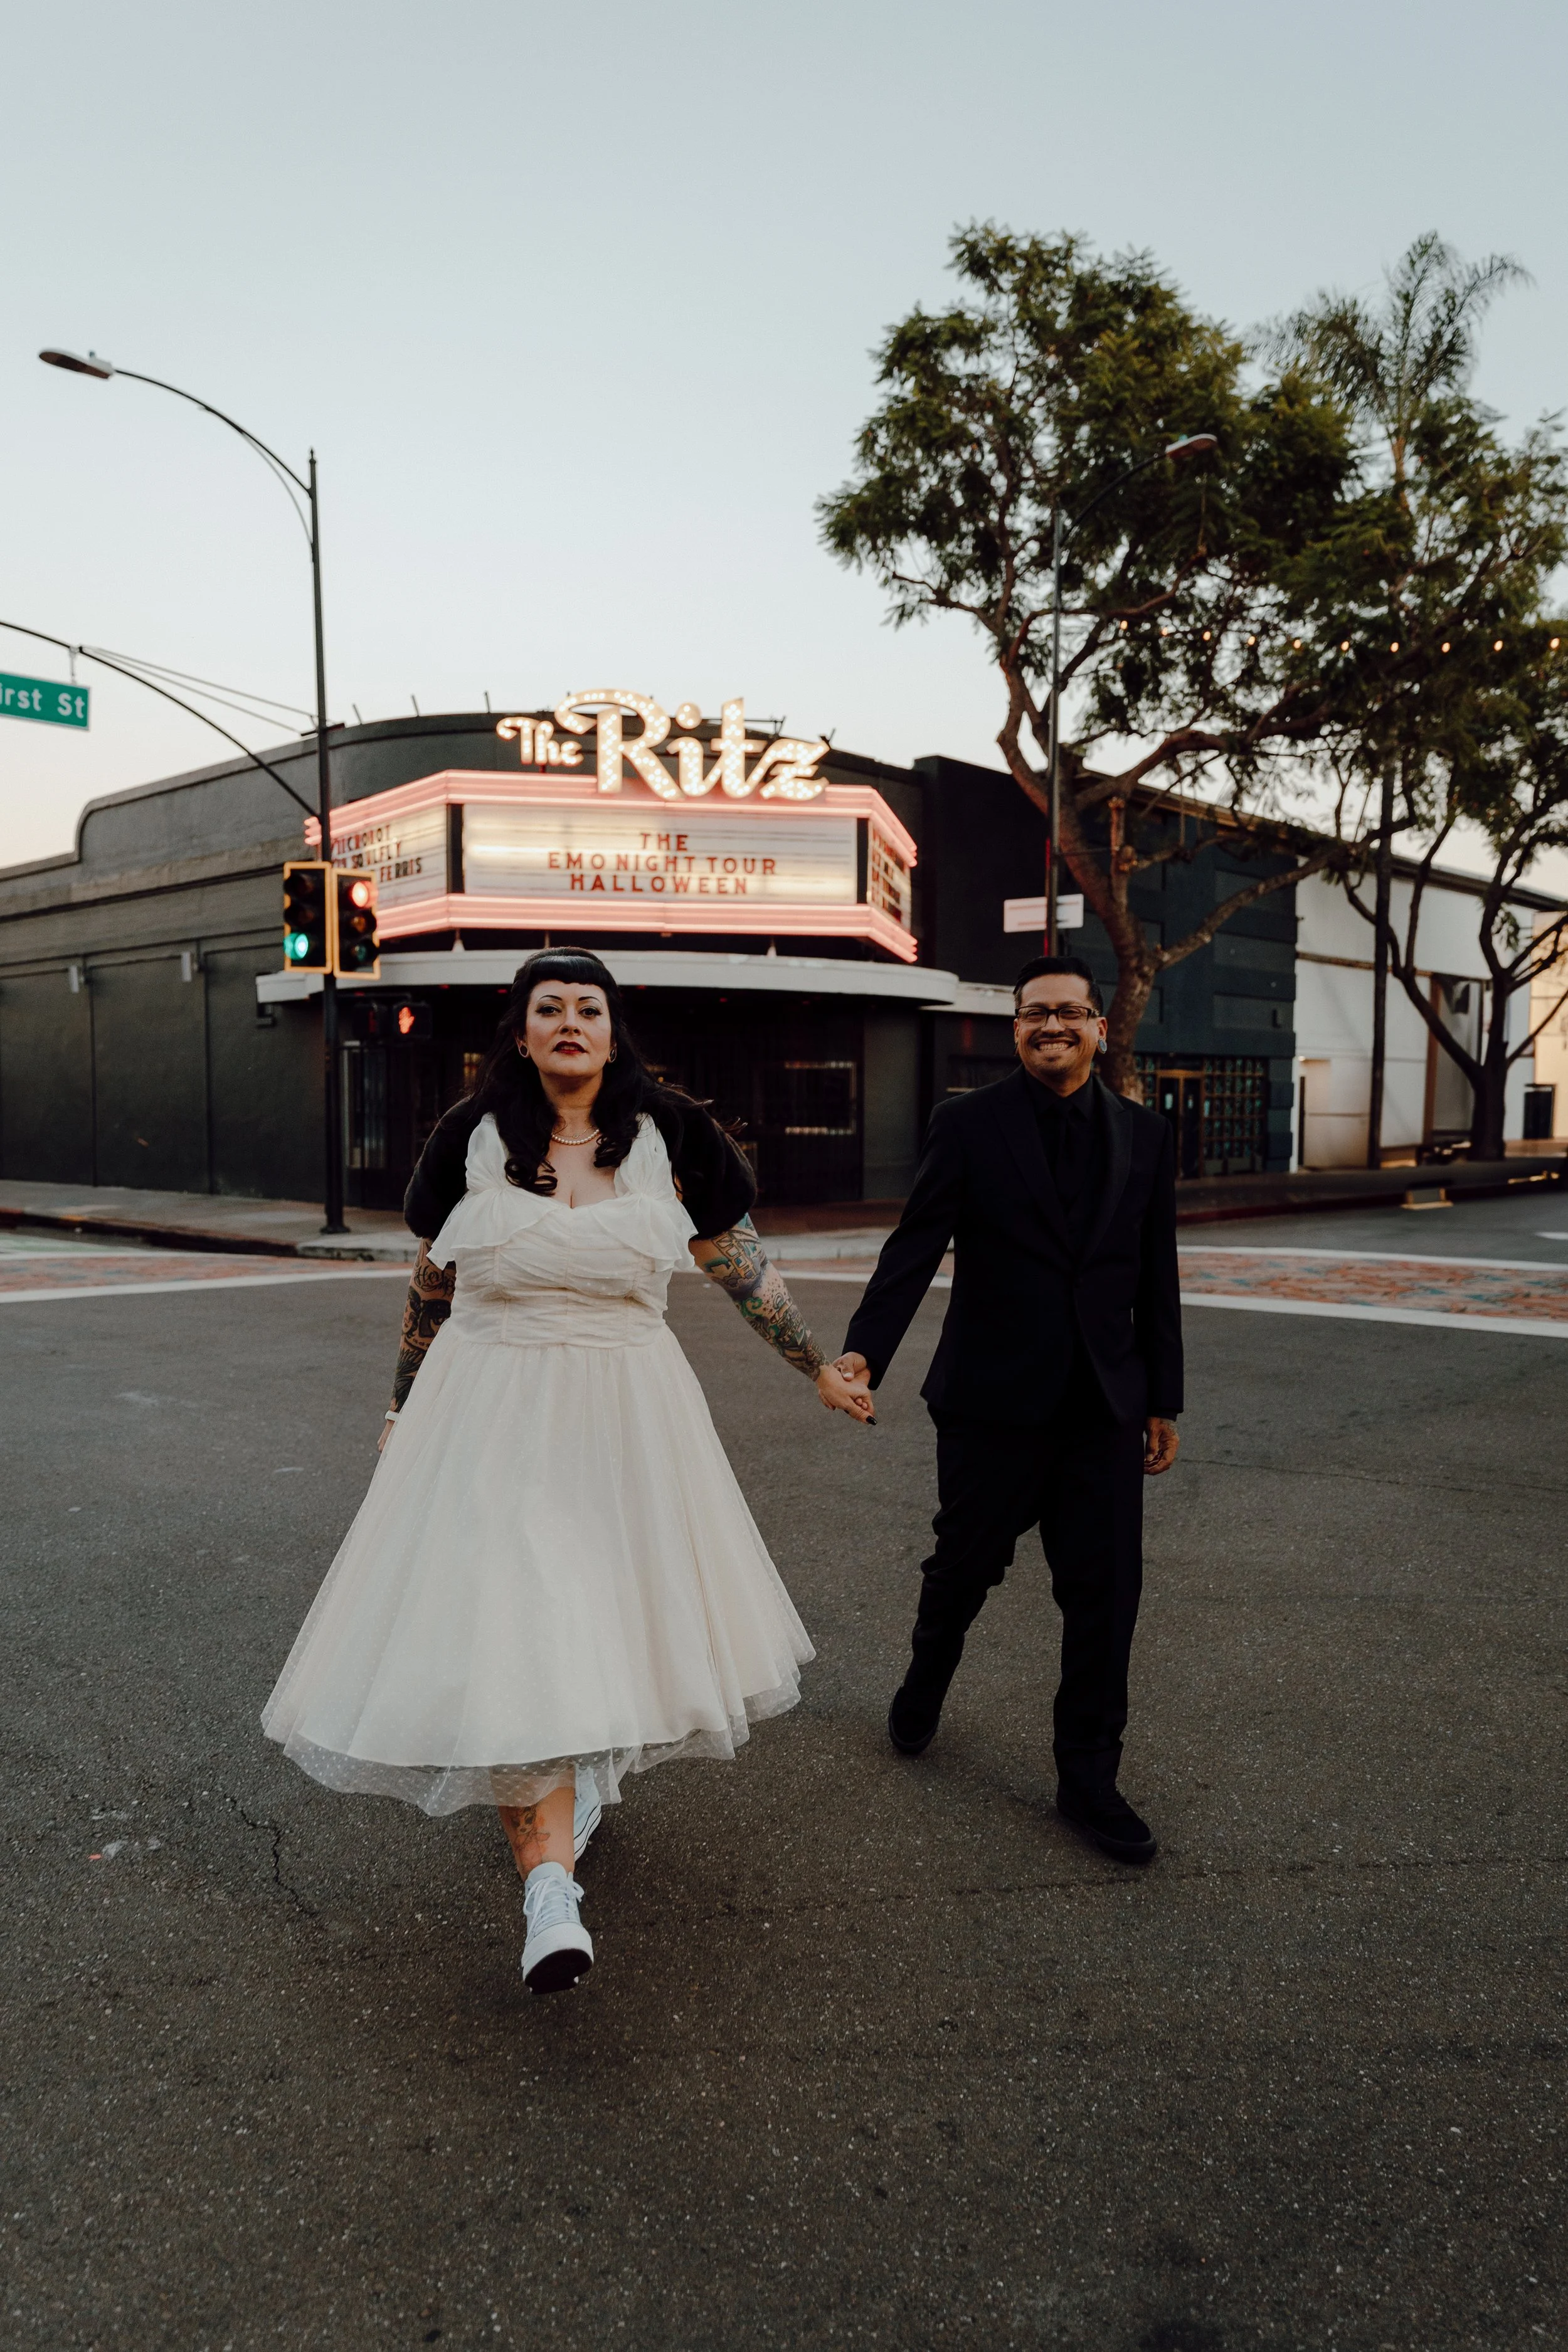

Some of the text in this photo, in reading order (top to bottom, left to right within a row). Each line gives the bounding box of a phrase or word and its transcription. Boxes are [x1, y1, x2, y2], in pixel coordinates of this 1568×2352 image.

[57, 692, 85, 719] St
[496, 689, 830, 801] The Ritz
[640, 833, 688, 851] THE
[548, 852, 776, 875] EMO NIGHT TOUR
[571, 874, 747, 894] HALLOWEEN
